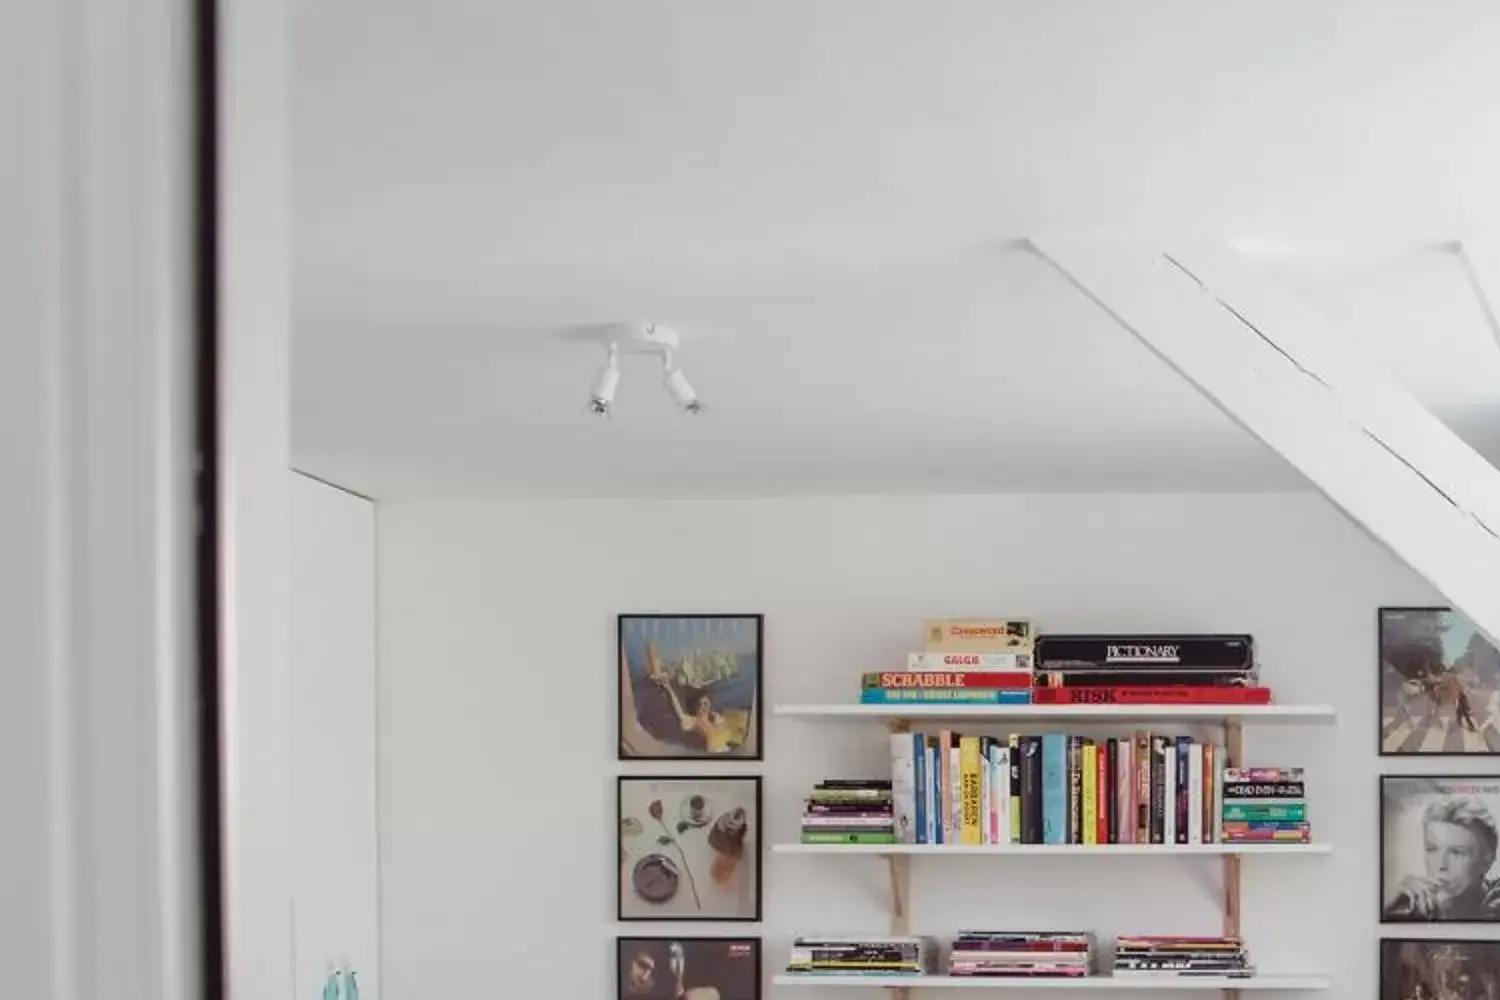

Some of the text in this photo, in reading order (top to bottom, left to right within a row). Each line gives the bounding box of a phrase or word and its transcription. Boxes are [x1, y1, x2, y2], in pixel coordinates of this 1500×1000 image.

[1107, 645, 1181, 658] PICTIONARY
[880, 673, 965, 687] SCRABBLE
[1072, 687, 1115, 703] RISK
